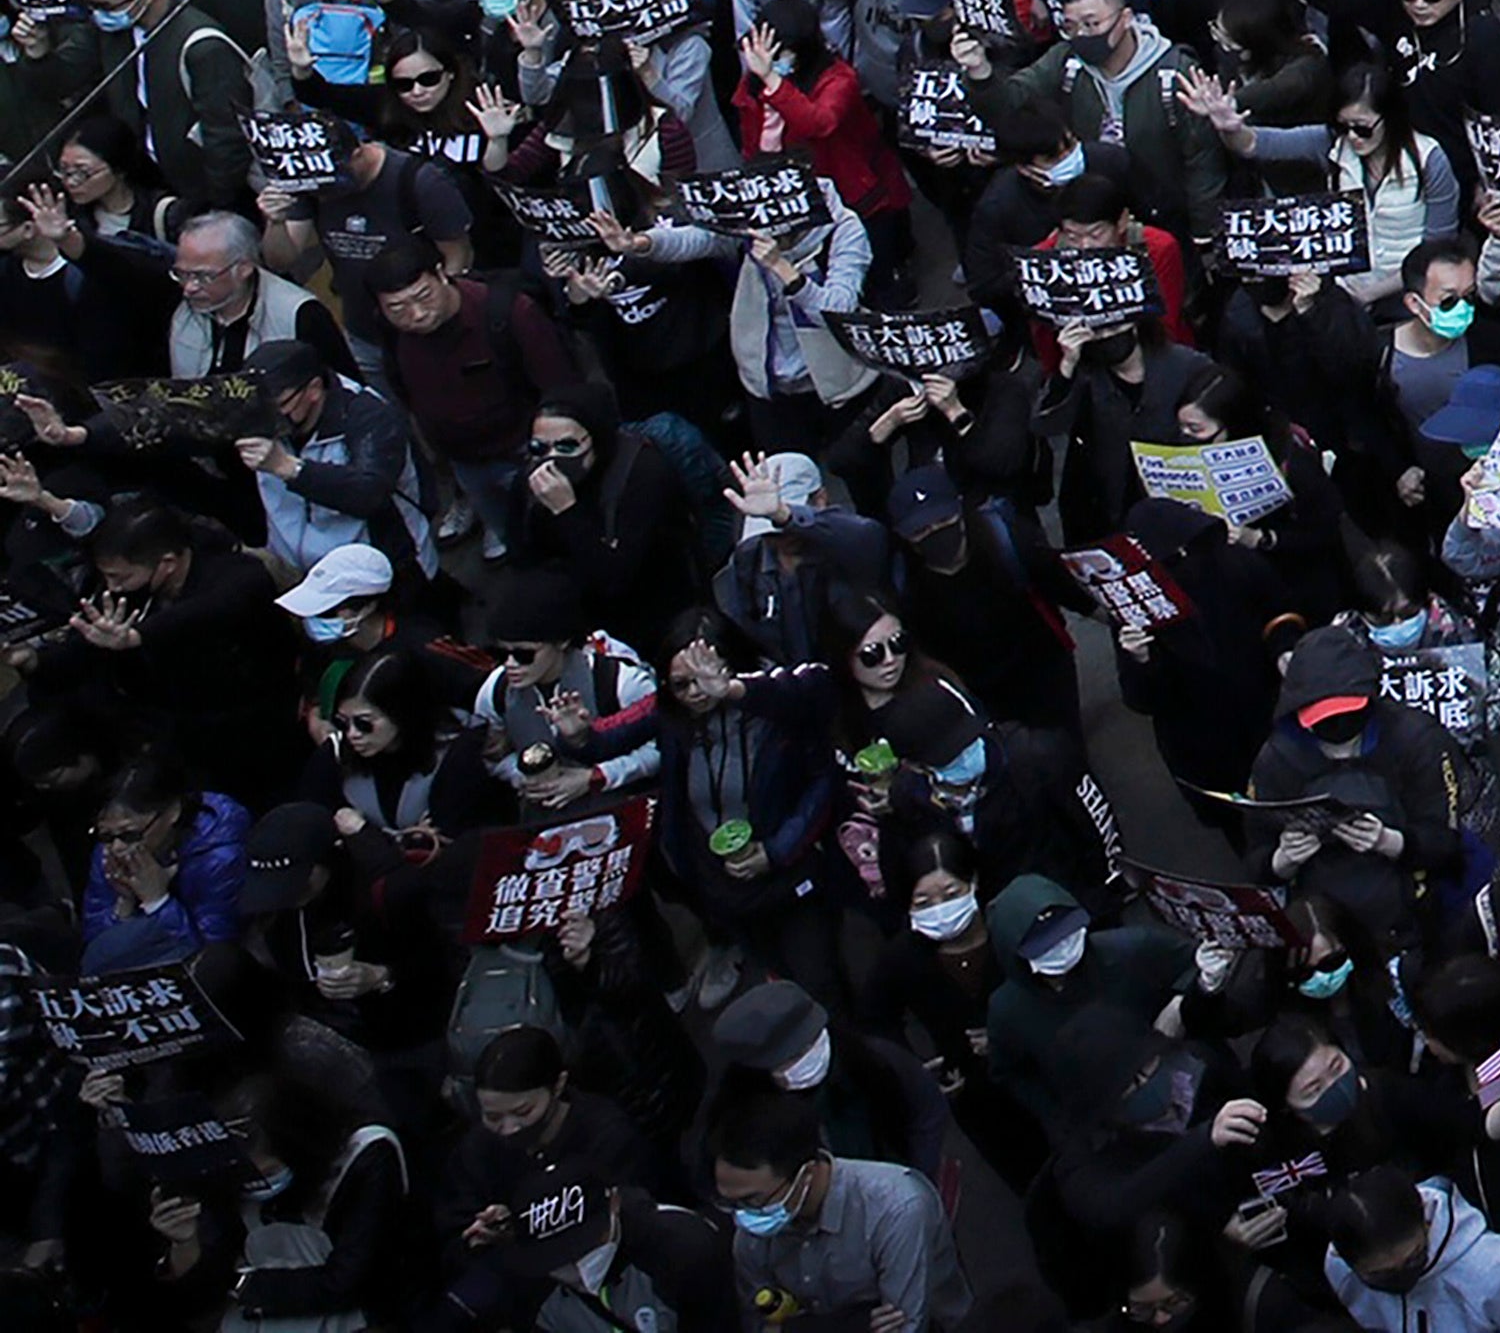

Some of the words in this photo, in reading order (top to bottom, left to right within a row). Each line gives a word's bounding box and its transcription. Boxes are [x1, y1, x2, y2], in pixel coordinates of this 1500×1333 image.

[1224, 206, 1351, 234] 五大訴求
[1021, 259, 1139, 282] 五大訴求
[39, 979, 184, 1022] 五大訴求
